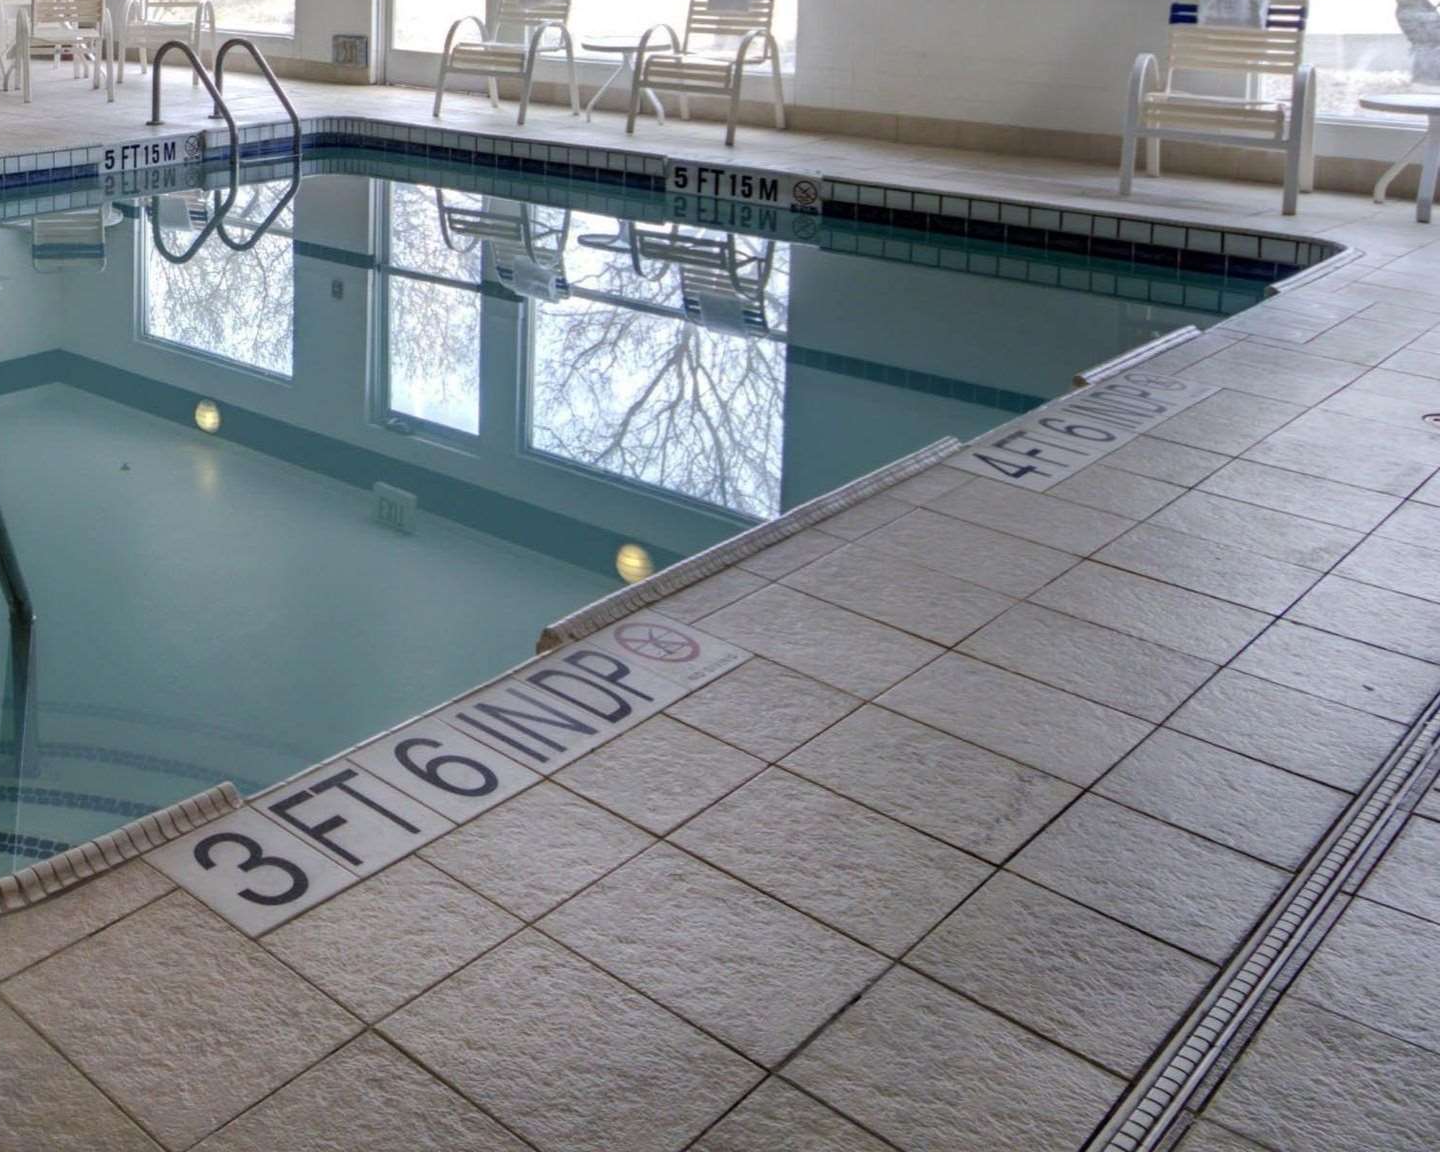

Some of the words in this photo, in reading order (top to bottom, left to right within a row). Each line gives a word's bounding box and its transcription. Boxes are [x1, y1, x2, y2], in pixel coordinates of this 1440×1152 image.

[104, 149, 115, 170] 5
[121, 144, 140, 169] FT
[163, 141, 176, 162] M
[674, 166, 688, 189] 5
[697, 167, 724, 196] FT
[759, 178, 779, 202] M
[1038, 417, 1117, 443] 6
[994, 430, 1092, 468] FT
[973, 452, 1052, 479] 4
[193, 832, 310, 907] 3
[267, 768, 421, 866] FT
[394, 737, 500, 798] 6
